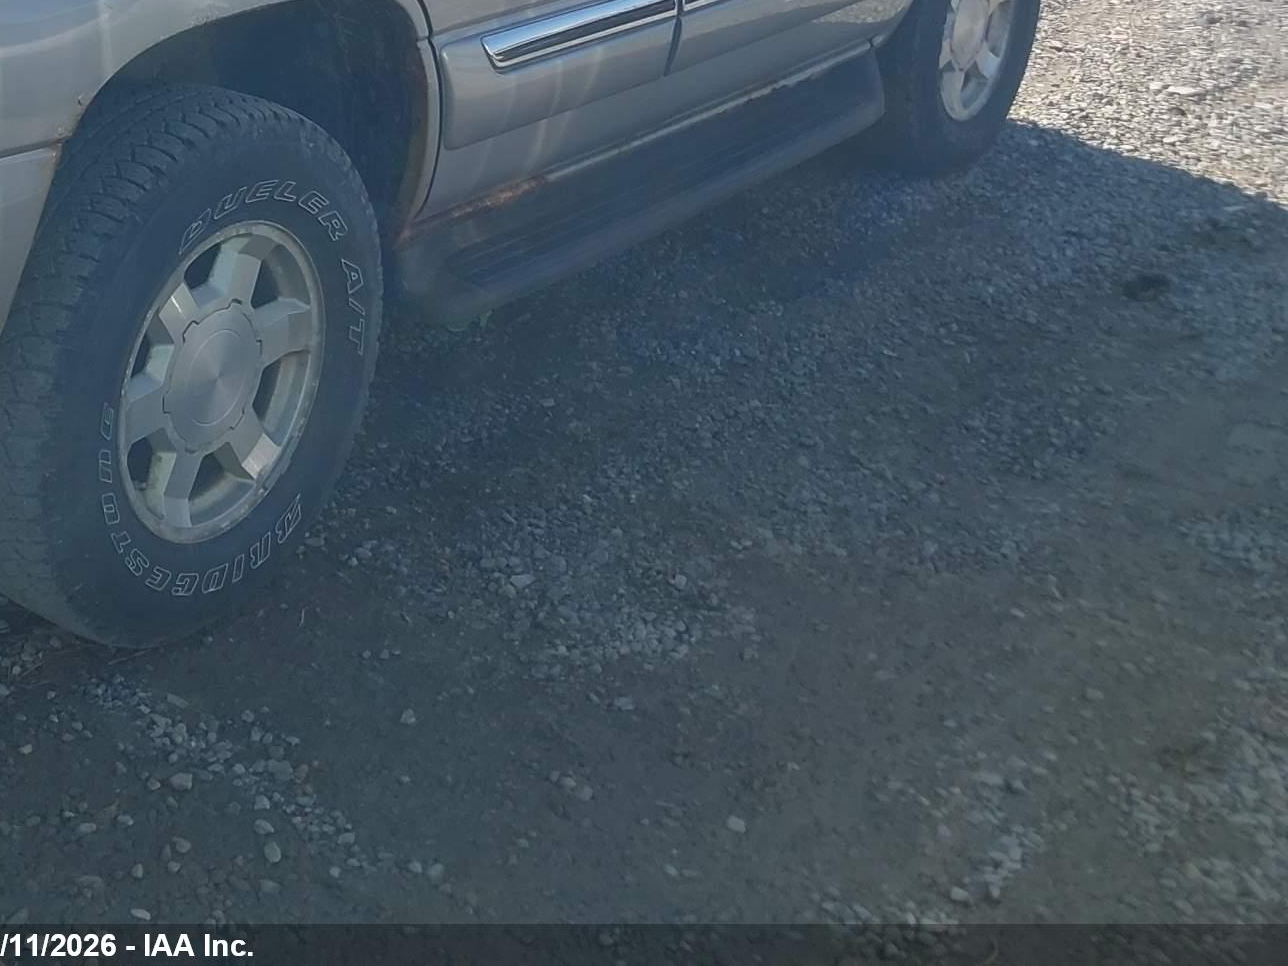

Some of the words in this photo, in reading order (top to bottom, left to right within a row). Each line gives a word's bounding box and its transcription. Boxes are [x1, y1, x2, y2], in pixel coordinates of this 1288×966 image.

[178, 179, 349, 255] DUELER
[341, 259, 366, 355] A/T
[98, 401, 303, 596] BRIDGESTONE
